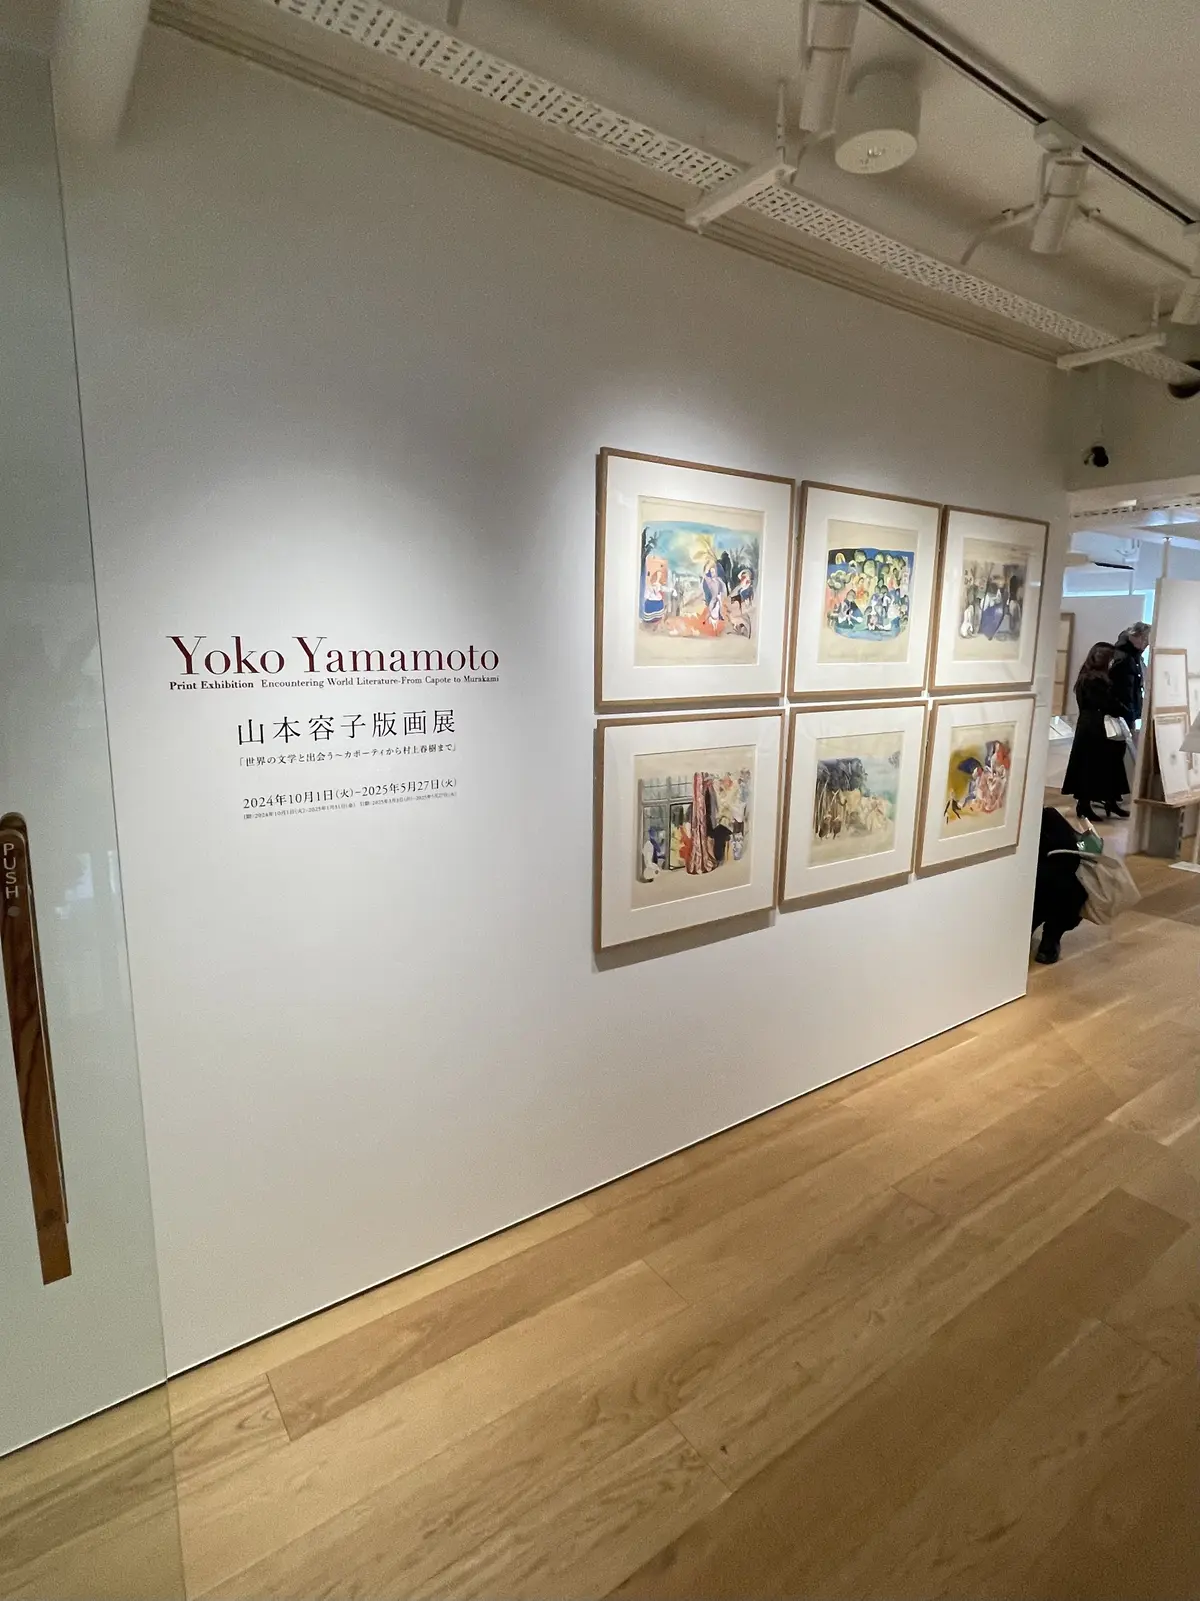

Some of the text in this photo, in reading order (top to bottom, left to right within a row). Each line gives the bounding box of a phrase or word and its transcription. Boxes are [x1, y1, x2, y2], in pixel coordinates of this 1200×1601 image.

[165, 635, 499, 676] Yoko Yamamoto
[169, 681, 197, 690] Print
[200, 680, 254, 690] Exhibition
[261, 678, 325, 688] Encountering
[326, 677, 353, 686] World
[425, 676, 452, 685] Capote
[463, 675, 499, 683] Murakami
[237, 709, 456, 746] 山本容子版画展
[3, 842, 19, 899] PUSH
